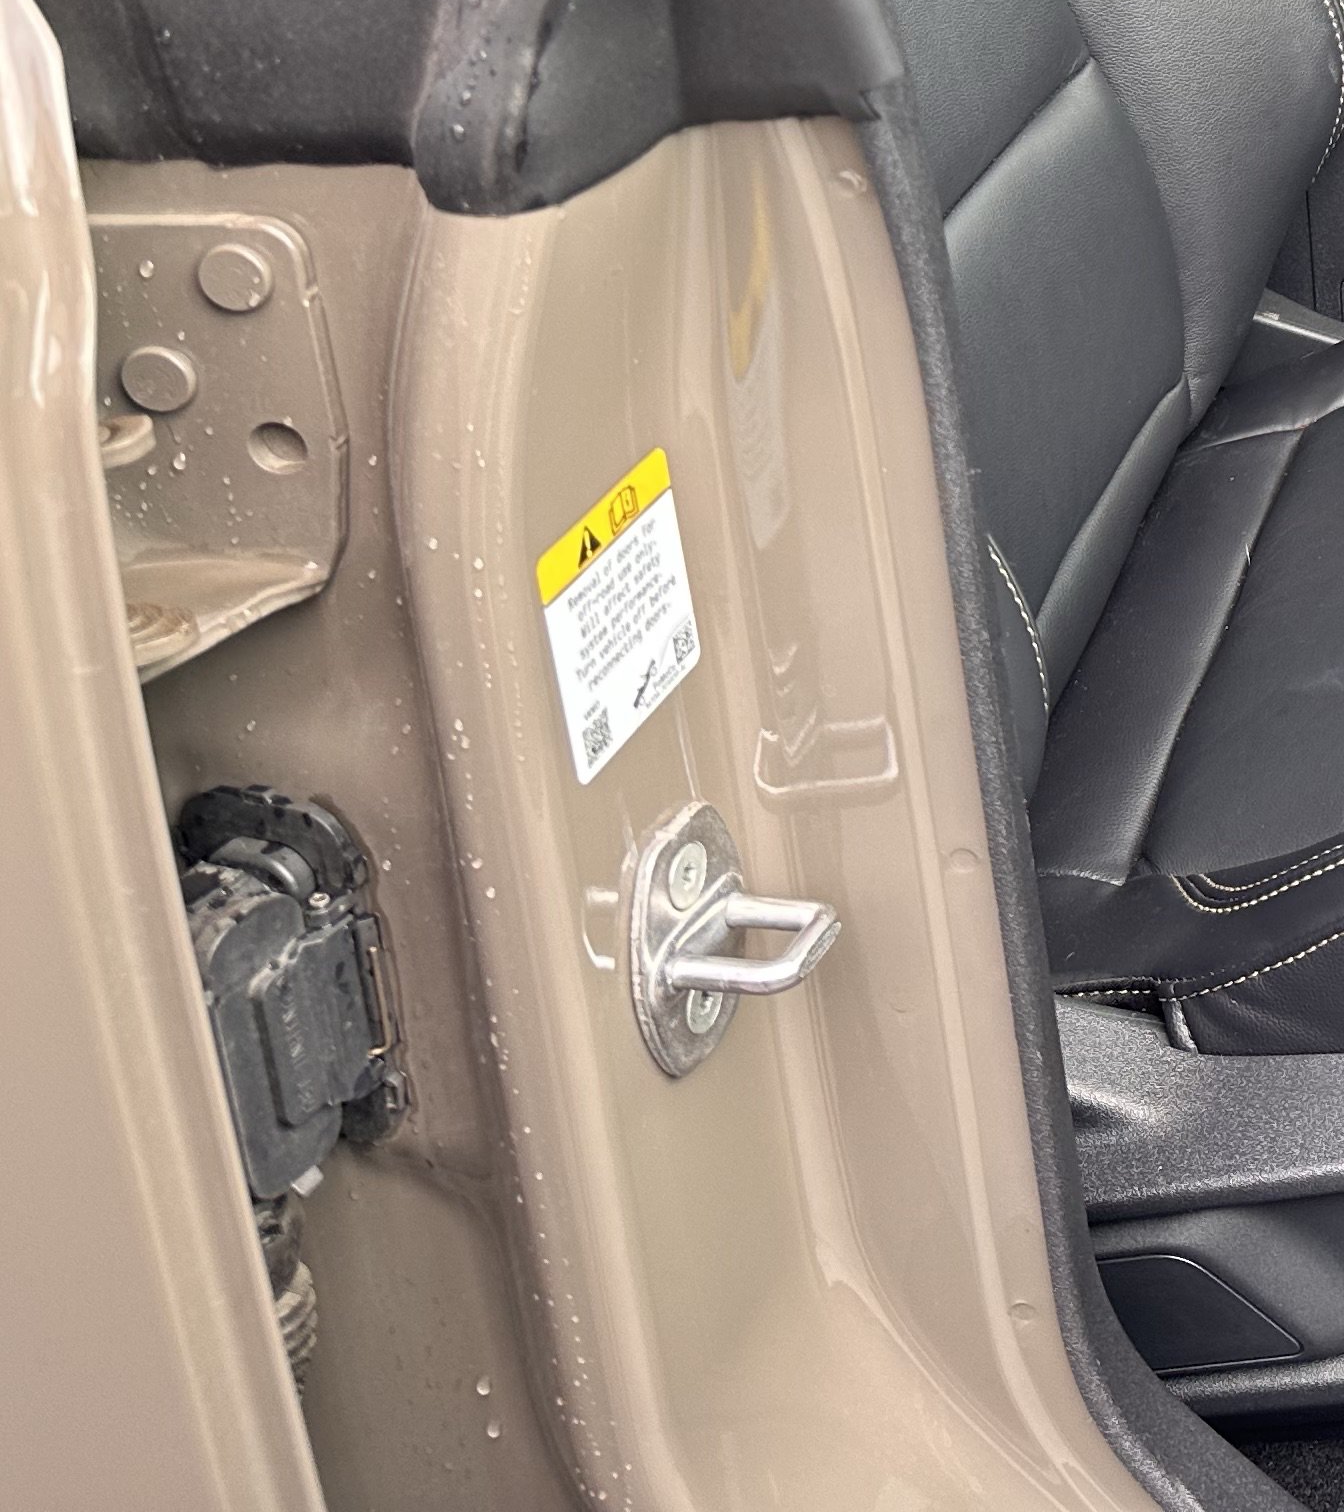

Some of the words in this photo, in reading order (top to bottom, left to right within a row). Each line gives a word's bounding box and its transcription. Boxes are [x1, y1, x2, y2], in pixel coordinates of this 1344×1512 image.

[567, 571, 600, 611] Removal
[602, 558, 613, 576] of
[615, 533, 639, 562] doors
[641, 516, 656, 538] for
[577, 577, 615, 621] off-road
[617, 561, 632, 581] use
[580, 611, 599, 638] Will
[602, 581, 631, 616] affect
[632, 551, 661, 586] safety
[575, 654, 596, 681] Turn
[598, 619, 631, 658] vehicle
[631, 604, 645, 624] off
[649, 573, 676, 606] before
[579, 625, 608, 661] system
[587, 628, 642, 690] reconnecting
